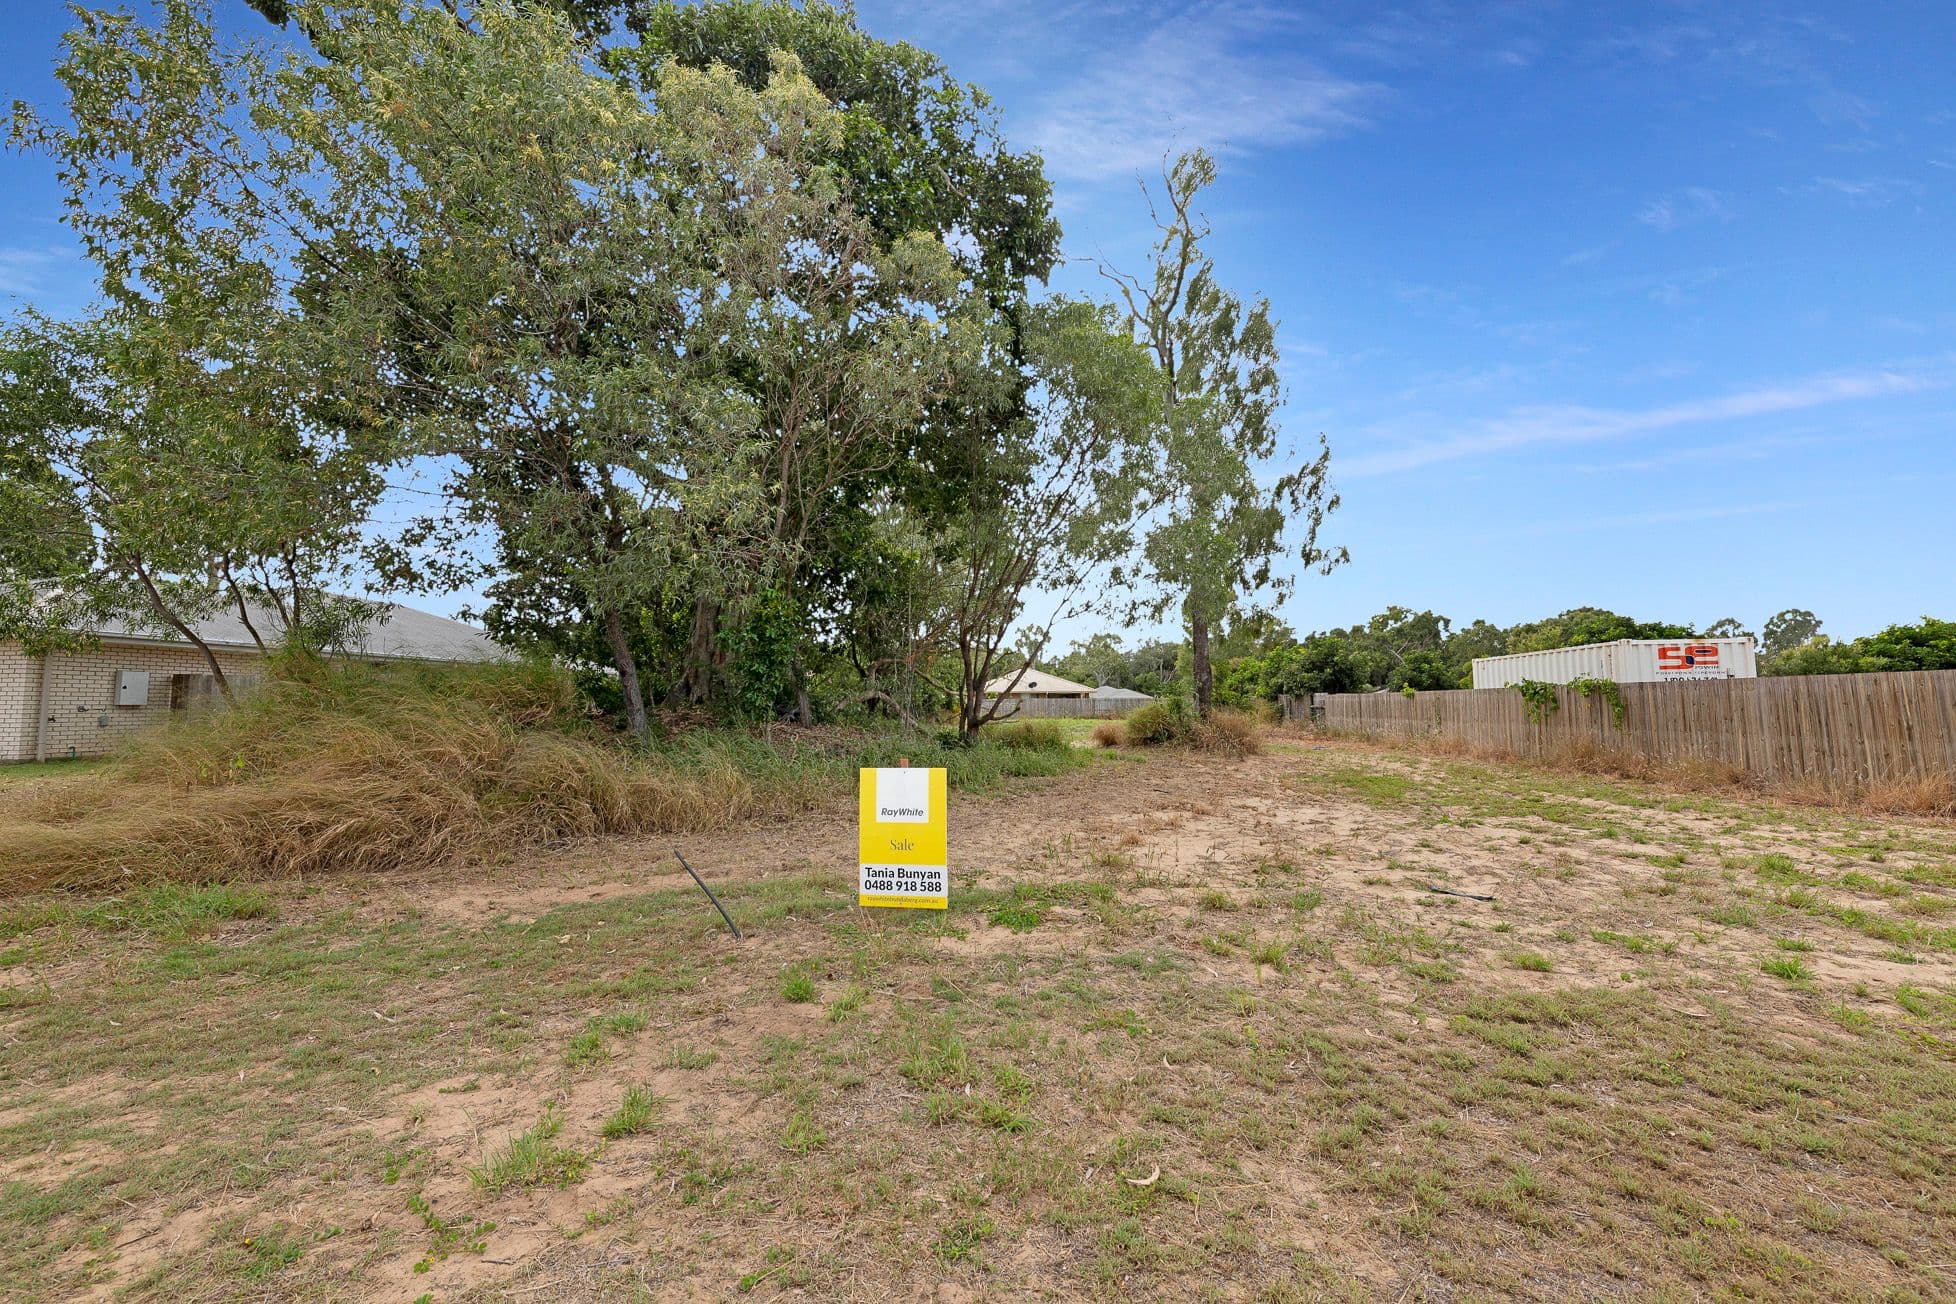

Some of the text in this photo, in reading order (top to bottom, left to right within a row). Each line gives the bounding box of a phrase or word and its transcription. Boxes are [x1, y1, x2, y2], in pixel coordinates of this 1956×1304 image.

[890, 838, 914, 851] Sale
[865, 867, 941, 881] Tania Bunyan
[865, 880, 942, 892] 0488 918 588
